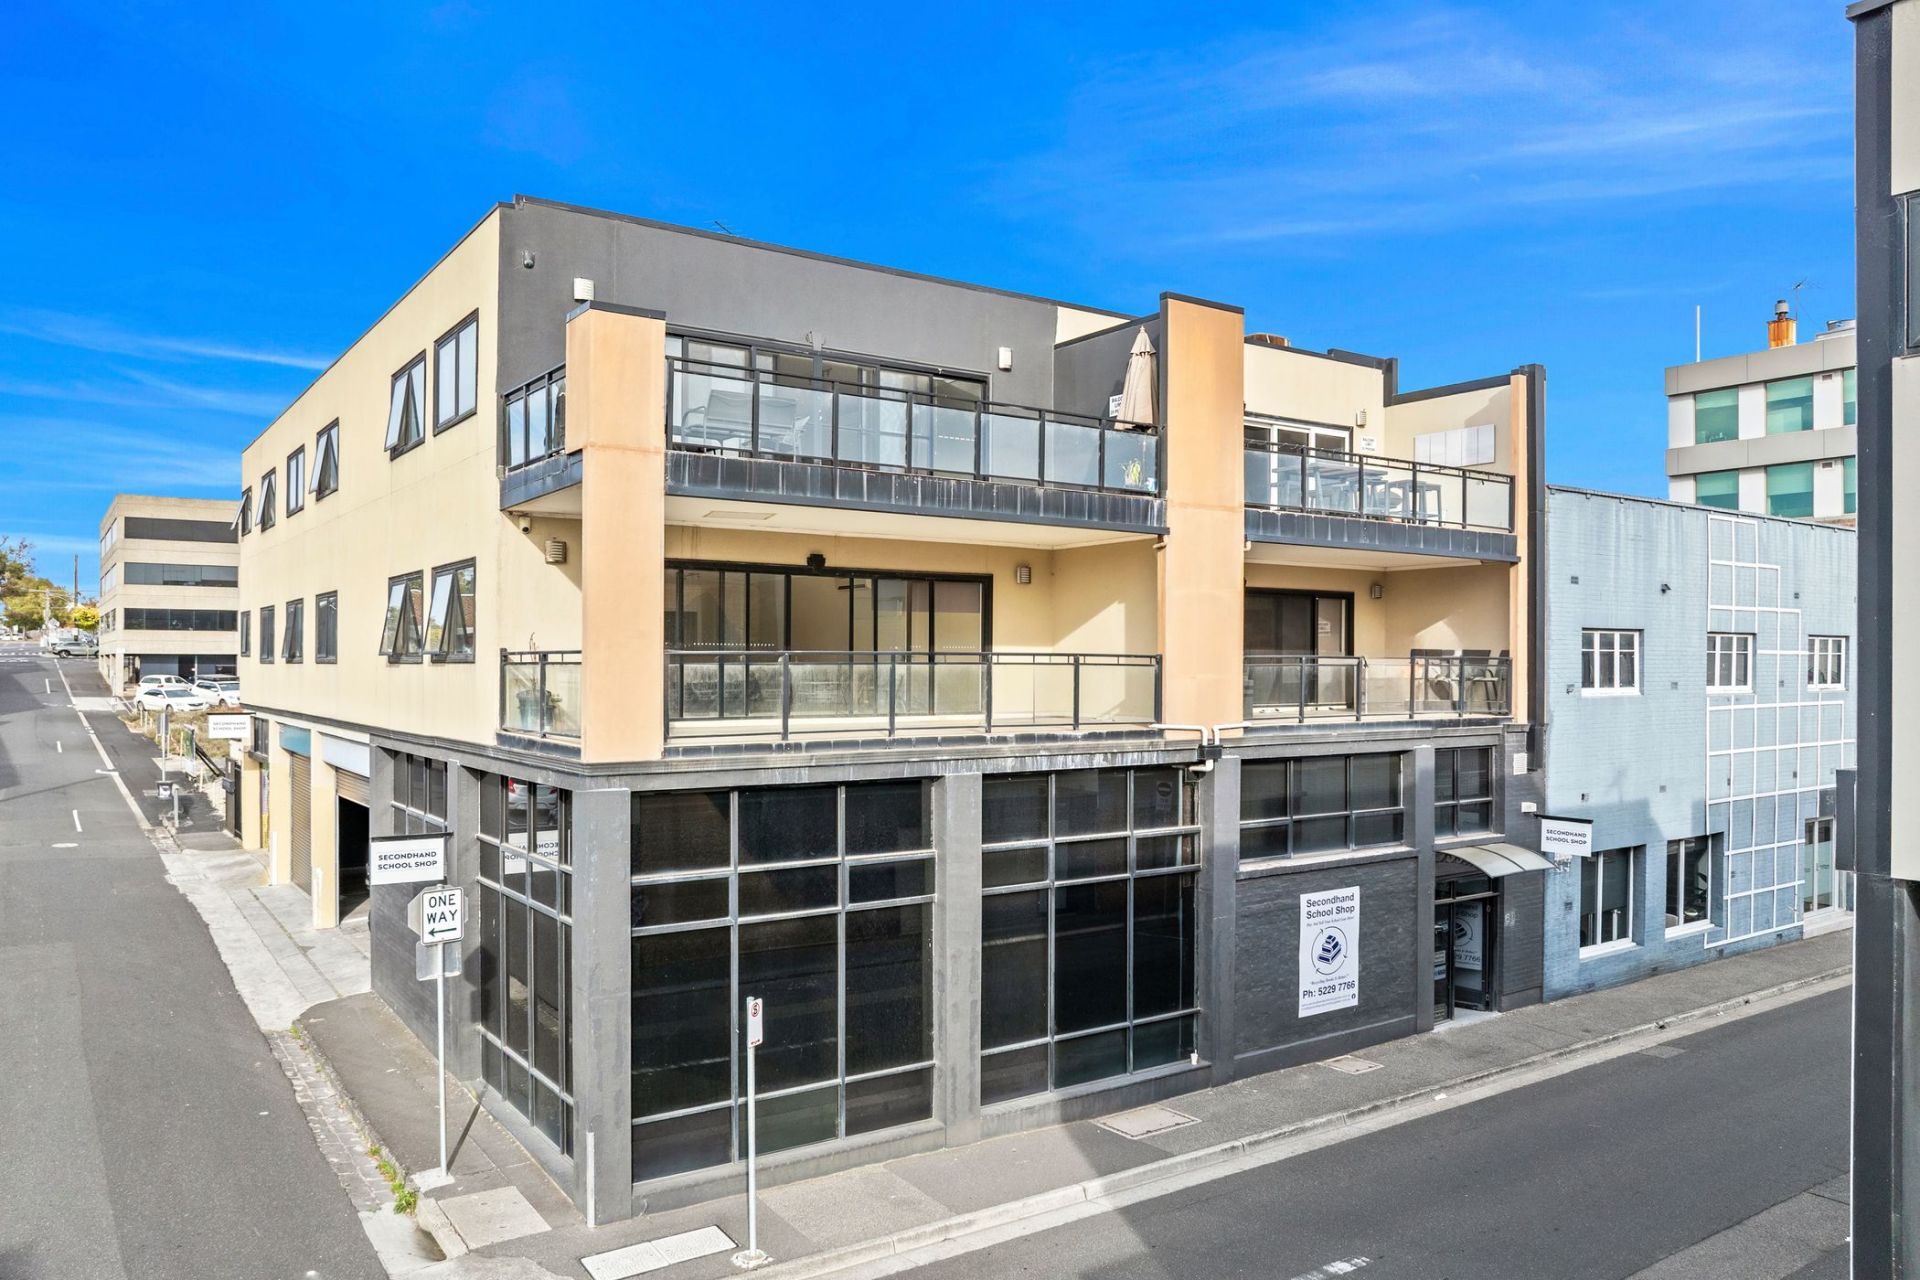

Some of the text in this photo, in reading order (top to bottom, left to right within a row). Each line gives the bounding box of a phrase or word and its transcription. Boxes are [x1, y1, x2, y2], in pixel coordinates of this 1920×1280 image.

[1545, 836, 1569, 844] SCHOOL
[1546, 829, 1587, 839] SECONDHAND
[378, 851, 437, 861] SECONDHAND
[377, 860, 438, 871] SCHOOL SHOP
[428, 893, 456, 908] ONE
[1306, 893, 1355, 908] Secondhand
[427, 909, 458, 925] WAY
[1306, 905, 1355, 920] School Shop
[1302, 980, 1356, 999] Ph: 5229 7766
